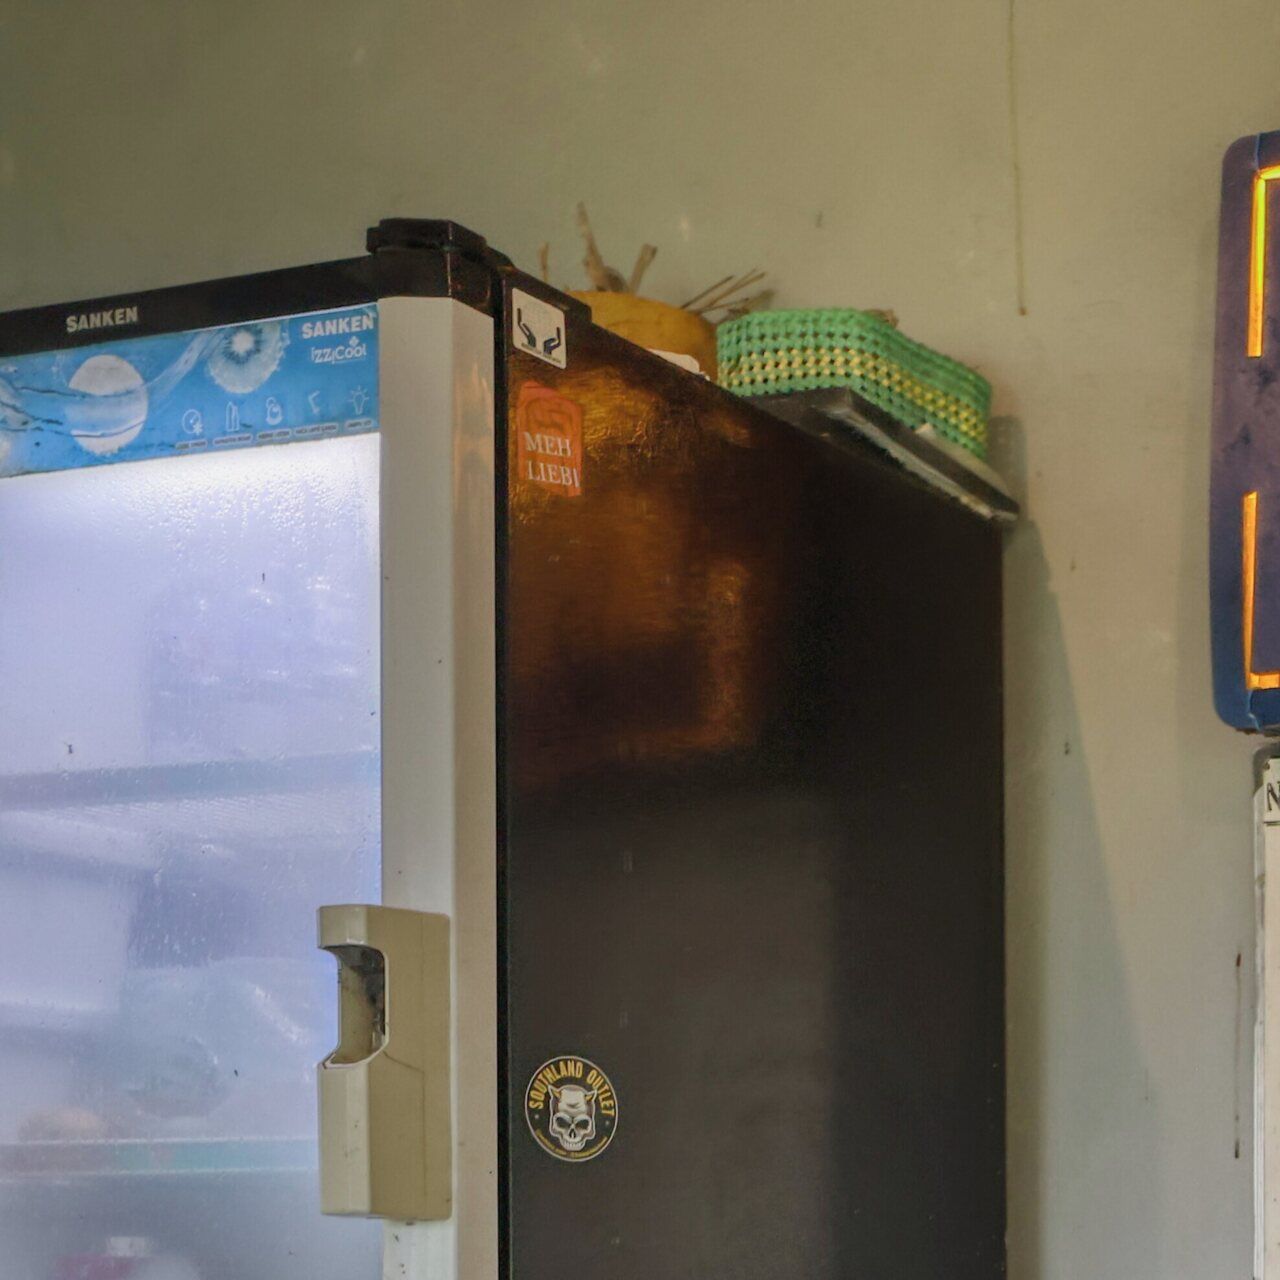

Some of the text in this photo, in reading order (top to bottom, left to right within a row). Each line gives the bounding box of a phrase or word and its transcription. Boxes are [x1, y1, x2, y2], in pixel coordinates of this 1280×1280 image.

[66, 306, 138, 333] SANKEN
[303, 315, 374, 339] SANKEN
[529, 1060, 615, 1117] SOUTHLAND OUTLET
